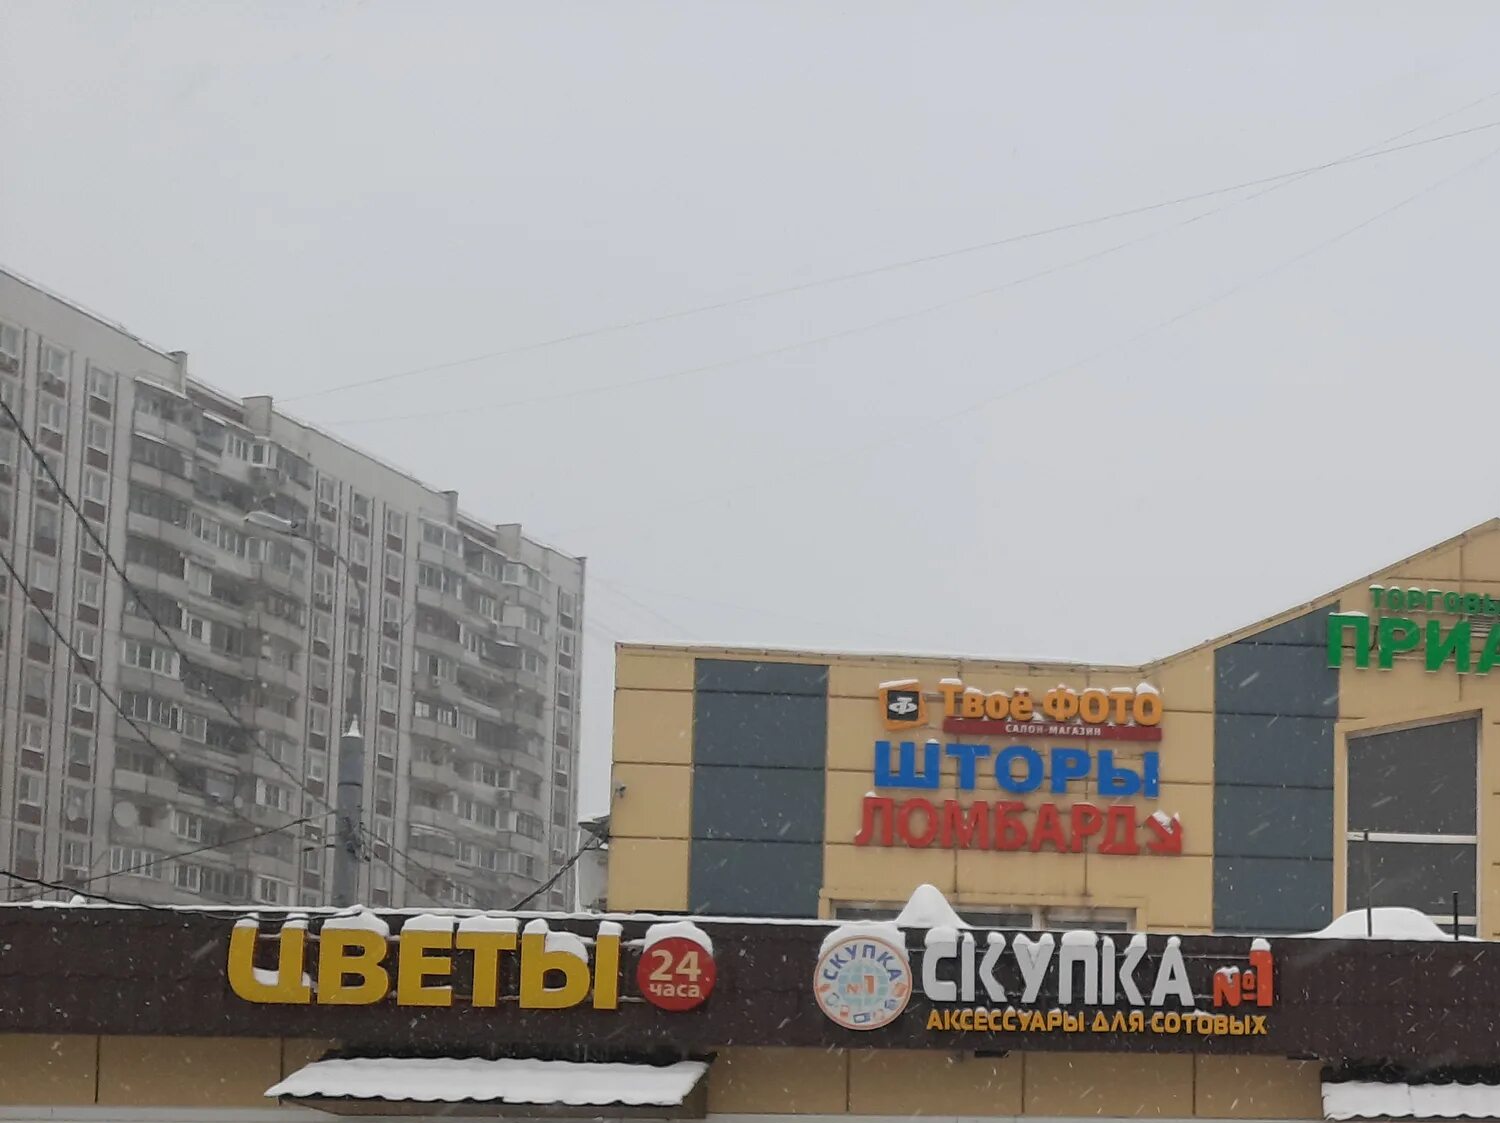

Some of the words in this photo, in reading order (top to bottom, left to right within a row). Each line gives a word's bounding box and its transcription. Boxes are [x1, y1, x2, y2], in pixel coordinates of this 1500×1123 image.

[938, 679, 1034, 721] Твоё
[874, 740, 1159, 799] ШТОРЫ
[854, 796, 1140, 856] ЛОМБАРД
[227, 918, 620, 1010] ЦВЕТЫ
[648, 950, 701, 981] 24
[823, 943, 902, 982] СКУПКА
[922, 933, 1196, 1007] СКУПКА
[1213, 949, 1273, 1007] №1
[925, 1009, 1085, 1033] АКСЕССУАРЫ
[1091, 1010, 1144, 1034] ДЛЯ
[1151, 1011, 1267, 1036] СОТОВЫХ
